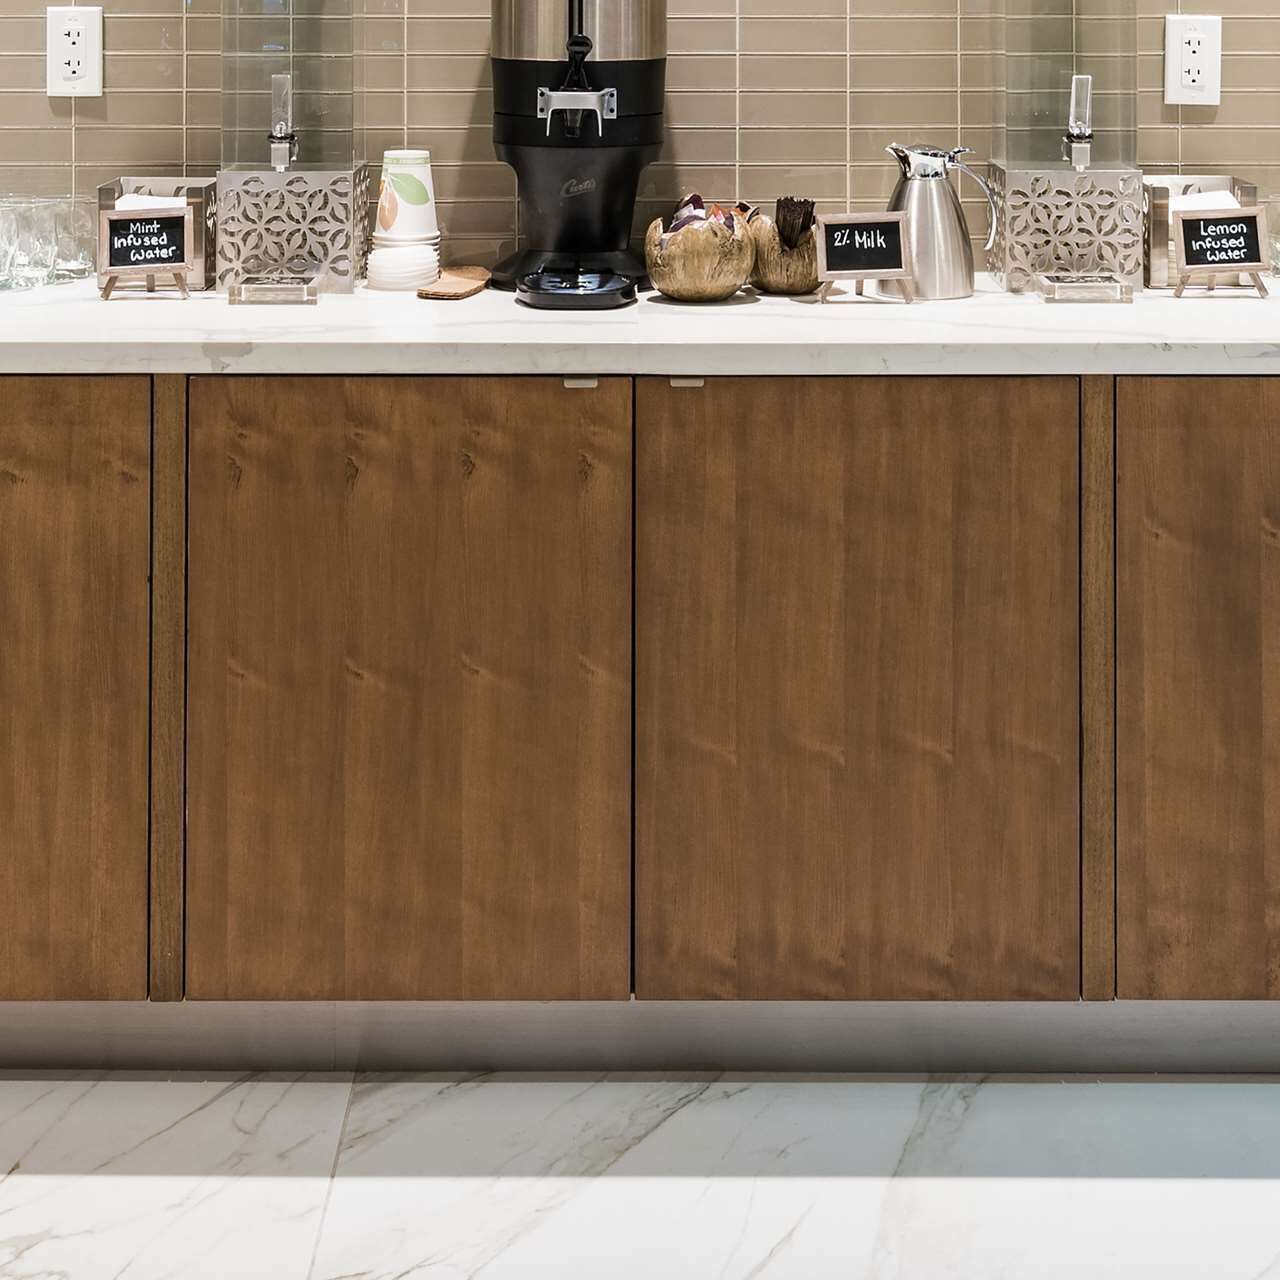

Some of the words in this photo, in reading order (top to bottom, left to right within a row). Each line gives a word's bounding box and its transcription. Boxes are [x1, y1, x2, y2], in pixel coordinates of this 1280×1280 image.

[130, 220, 160, 233] Mint
[1200, 220, 1247, 236] Lemon
[114, 232, 167, 248] Infused
[834, 229, 850, 246] 2%
[855, 229, 886, 249] Milk
[1191, 236, 1245, 250] Infused
[130, 246, 176, 261] Water
[1206, 249, 1247, 261] Water
